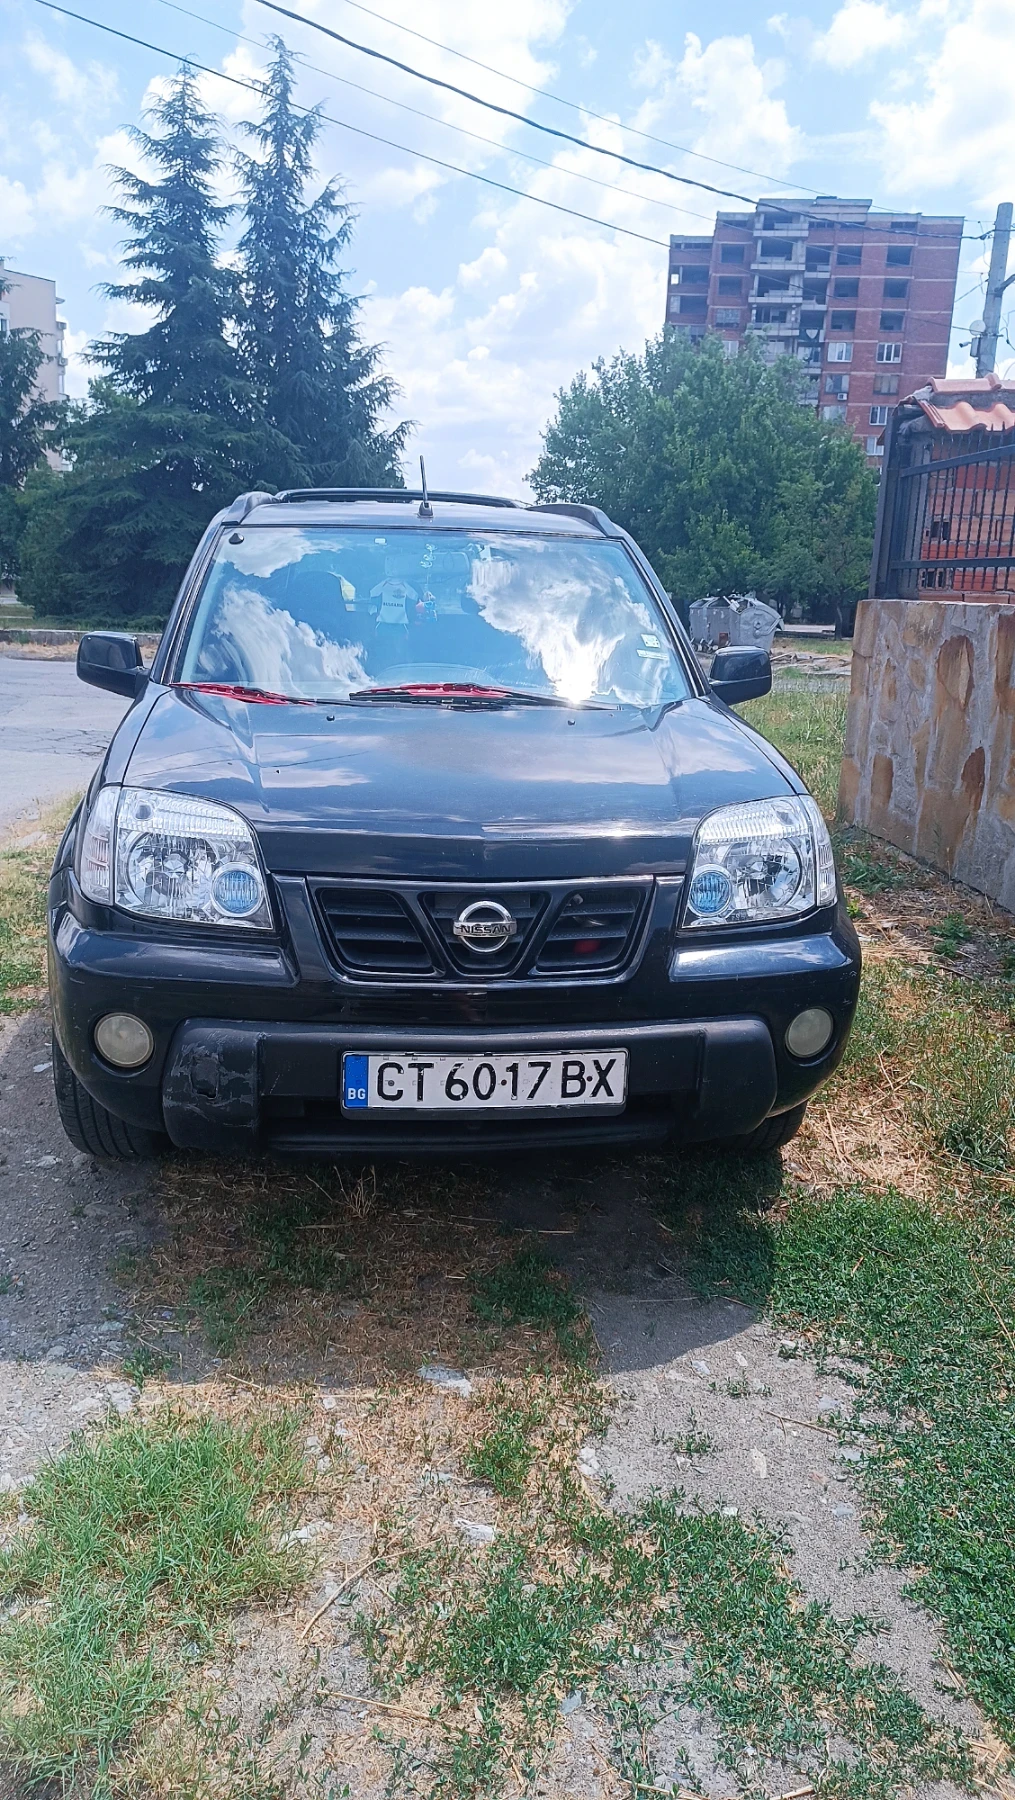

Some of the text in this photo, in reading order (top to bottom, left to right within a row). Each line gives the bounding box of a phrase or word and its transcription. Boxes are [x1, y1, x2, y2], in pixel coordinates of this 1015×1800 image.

[460, 924, 511, 934] NISSAN
[377, 1058, 617, 1102] CT 6017 BX
[348, 1087, 366, 1100] BG
